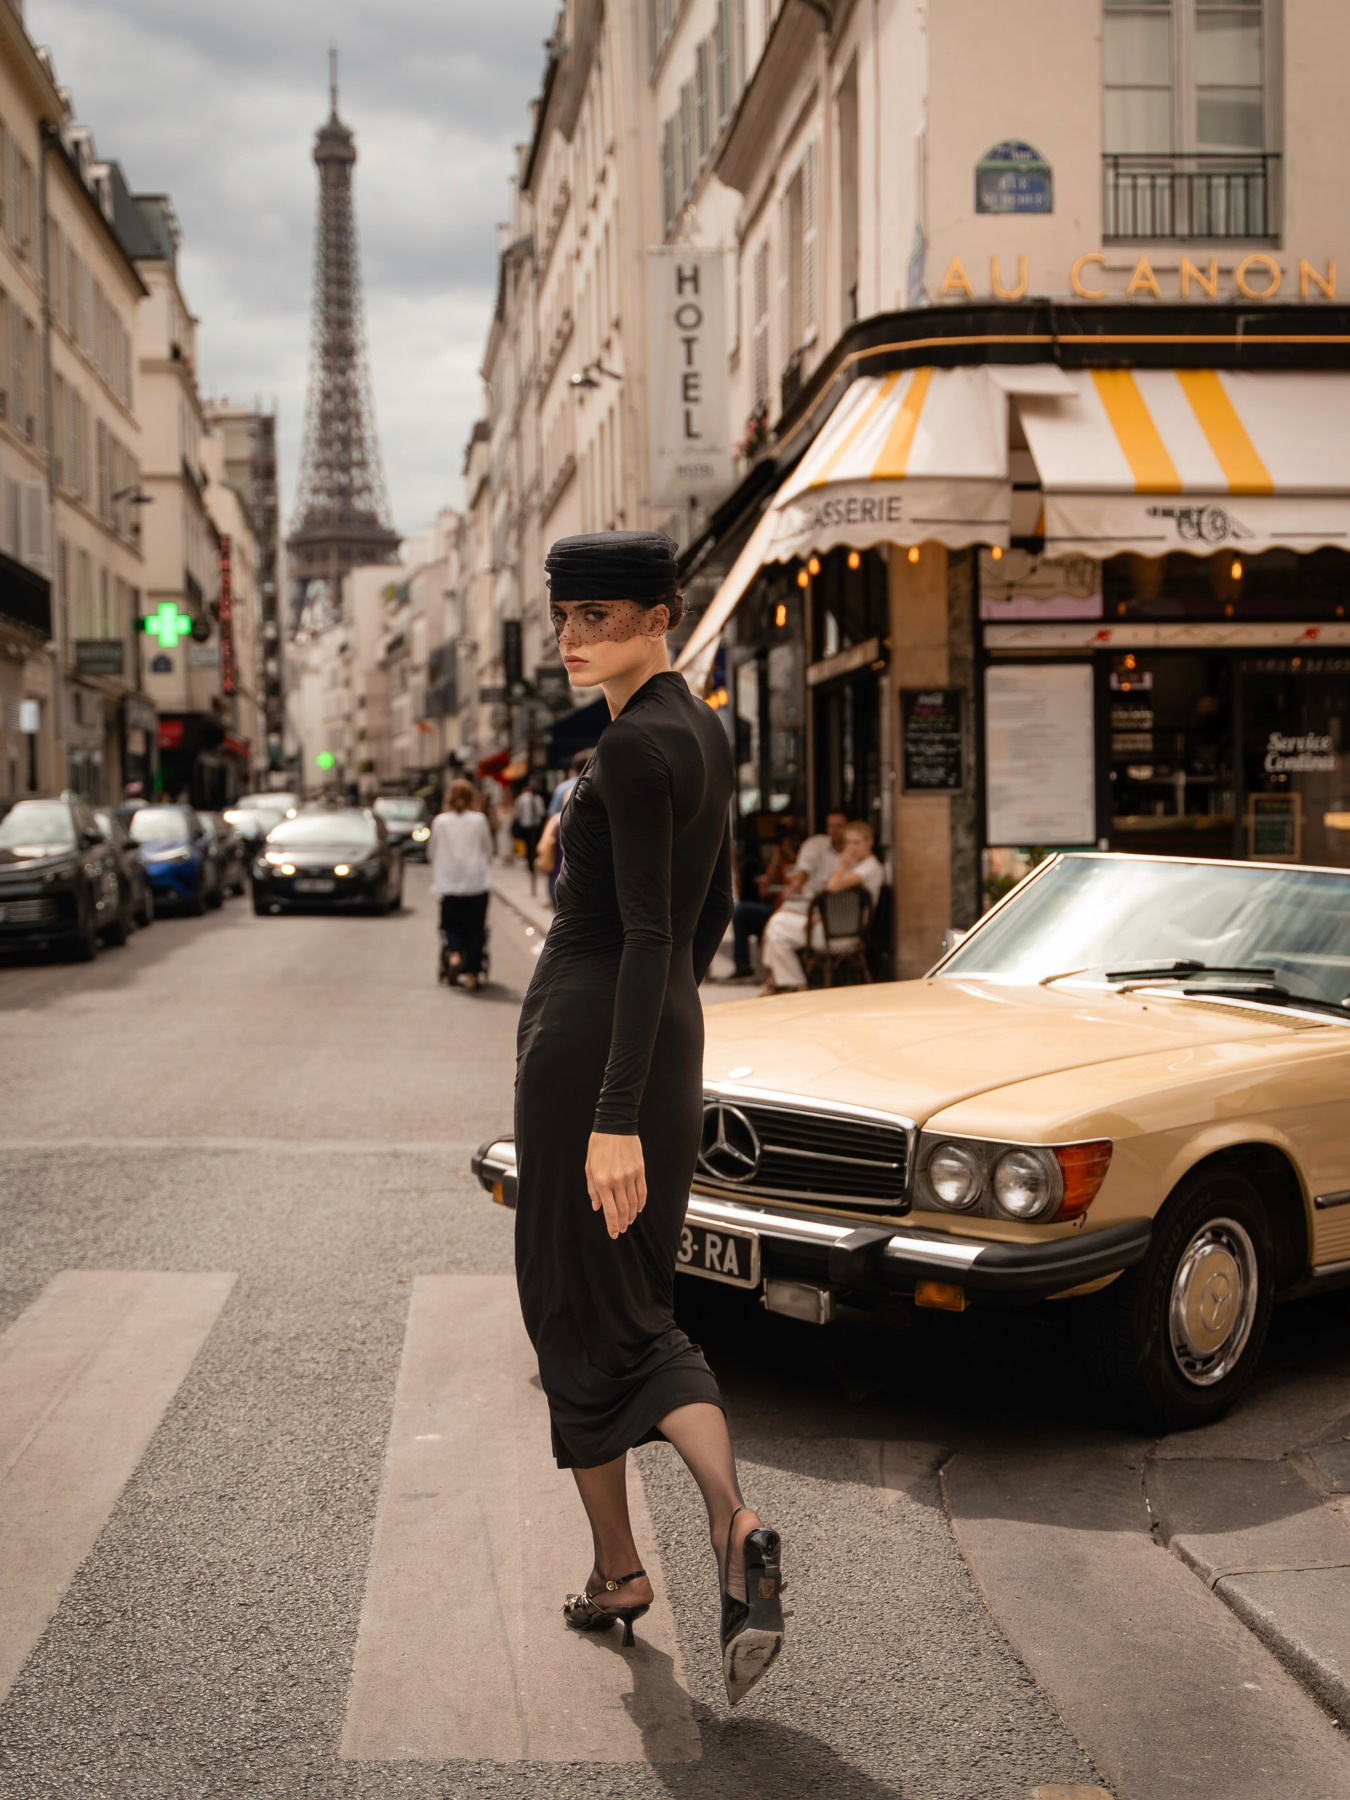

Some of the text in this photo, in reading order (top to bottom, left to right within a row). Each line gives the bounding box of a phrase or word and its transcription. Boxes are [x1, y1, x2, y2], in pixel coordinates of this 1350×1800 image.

[938, 253, 1337, 299] AU CANON
[674, 264, 703, 439] HOTEL
[1266, 731, 1333, 752] Service
